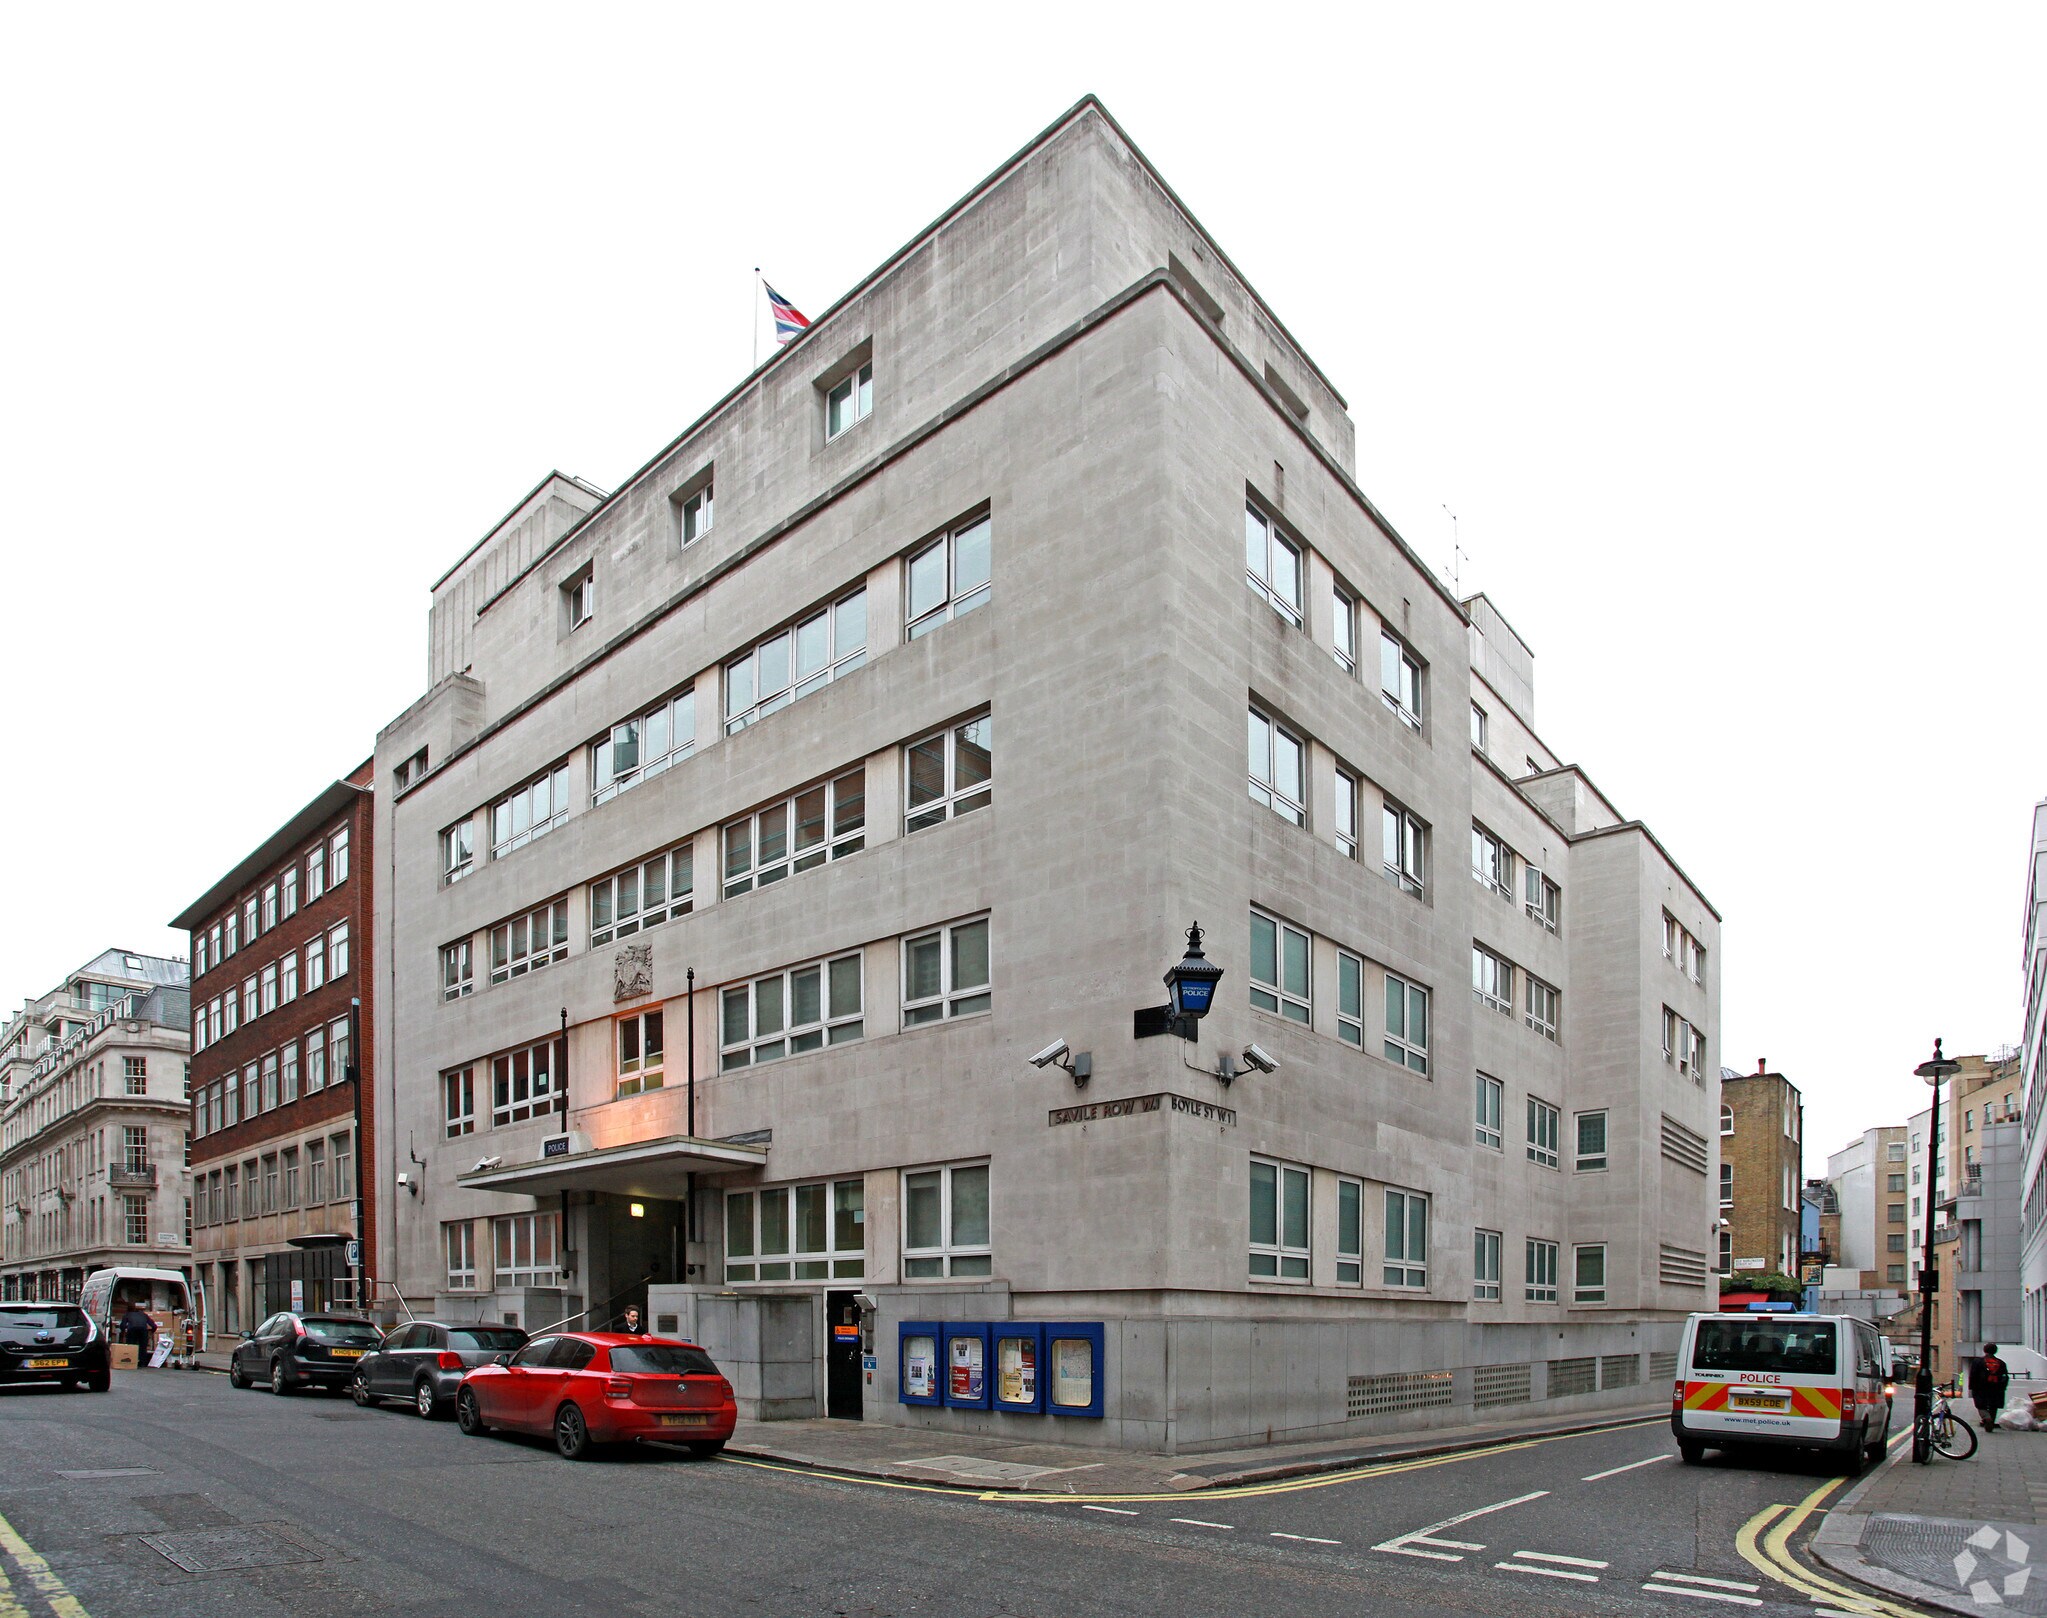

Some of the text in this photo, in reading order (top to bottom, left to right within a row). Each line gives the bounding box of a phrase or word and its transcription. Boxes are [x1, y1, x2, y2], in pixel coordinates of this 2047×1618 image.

[1055, 1106, 1097, 1125] SAVILE
[1103, 1099, 1135, 1118] ROW
[1171, 1096, 1202, 1117] BOYLE
[1203, 1105, 1215, 1121] ST
[547, 1142, 566, 1153] POLICE
[1739, 1373, 1781, 1384] POLICE
[1738, 1397, 1782, 1408] BX59 CDE
[1723, 1416, 1791, 1427] www.met.police.uk
